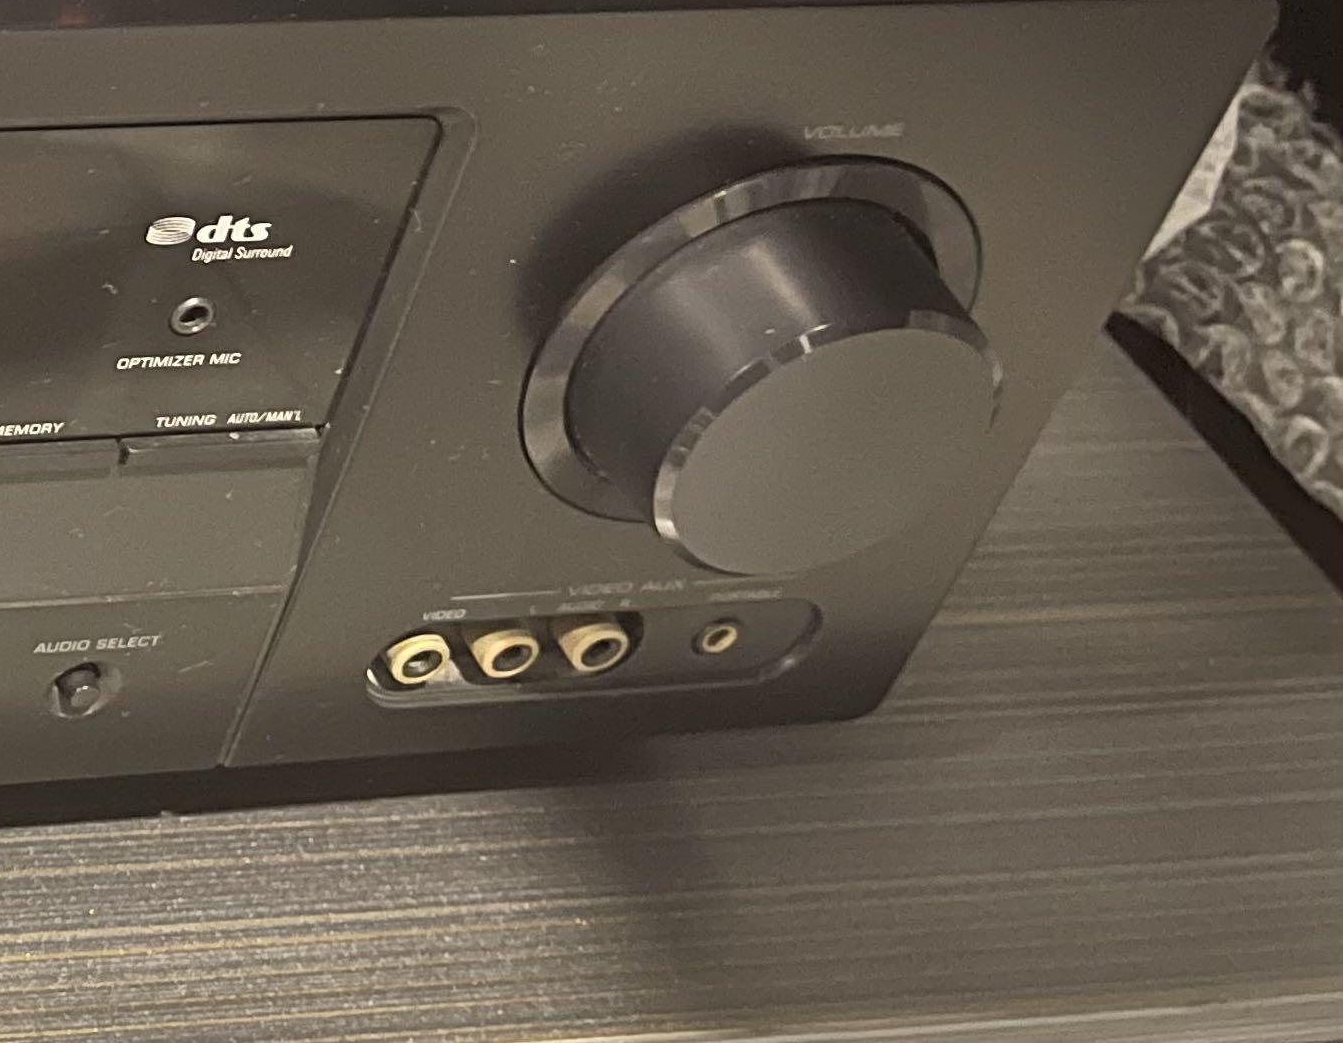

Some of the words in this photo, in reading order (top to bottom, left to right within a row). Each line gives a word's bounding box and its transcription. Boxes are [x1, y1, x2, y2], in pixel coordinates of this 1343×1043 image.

[803, 122, 905, 140] VOLUME
[195, 215, 273, 244] dts
[191, 246, 234, 264] Digital
[234, 244, 293, 260] Surround
[116, 354, 204, 371] OPTIMIZER
[209, 352, 242, 366] MIC
[155, 413, 217, 429] TUNING
[421, 608, 467, 622] VIDEO
[33, 638, 90, 654] AUDIO
[95, 634, 162, 651] SELECT
